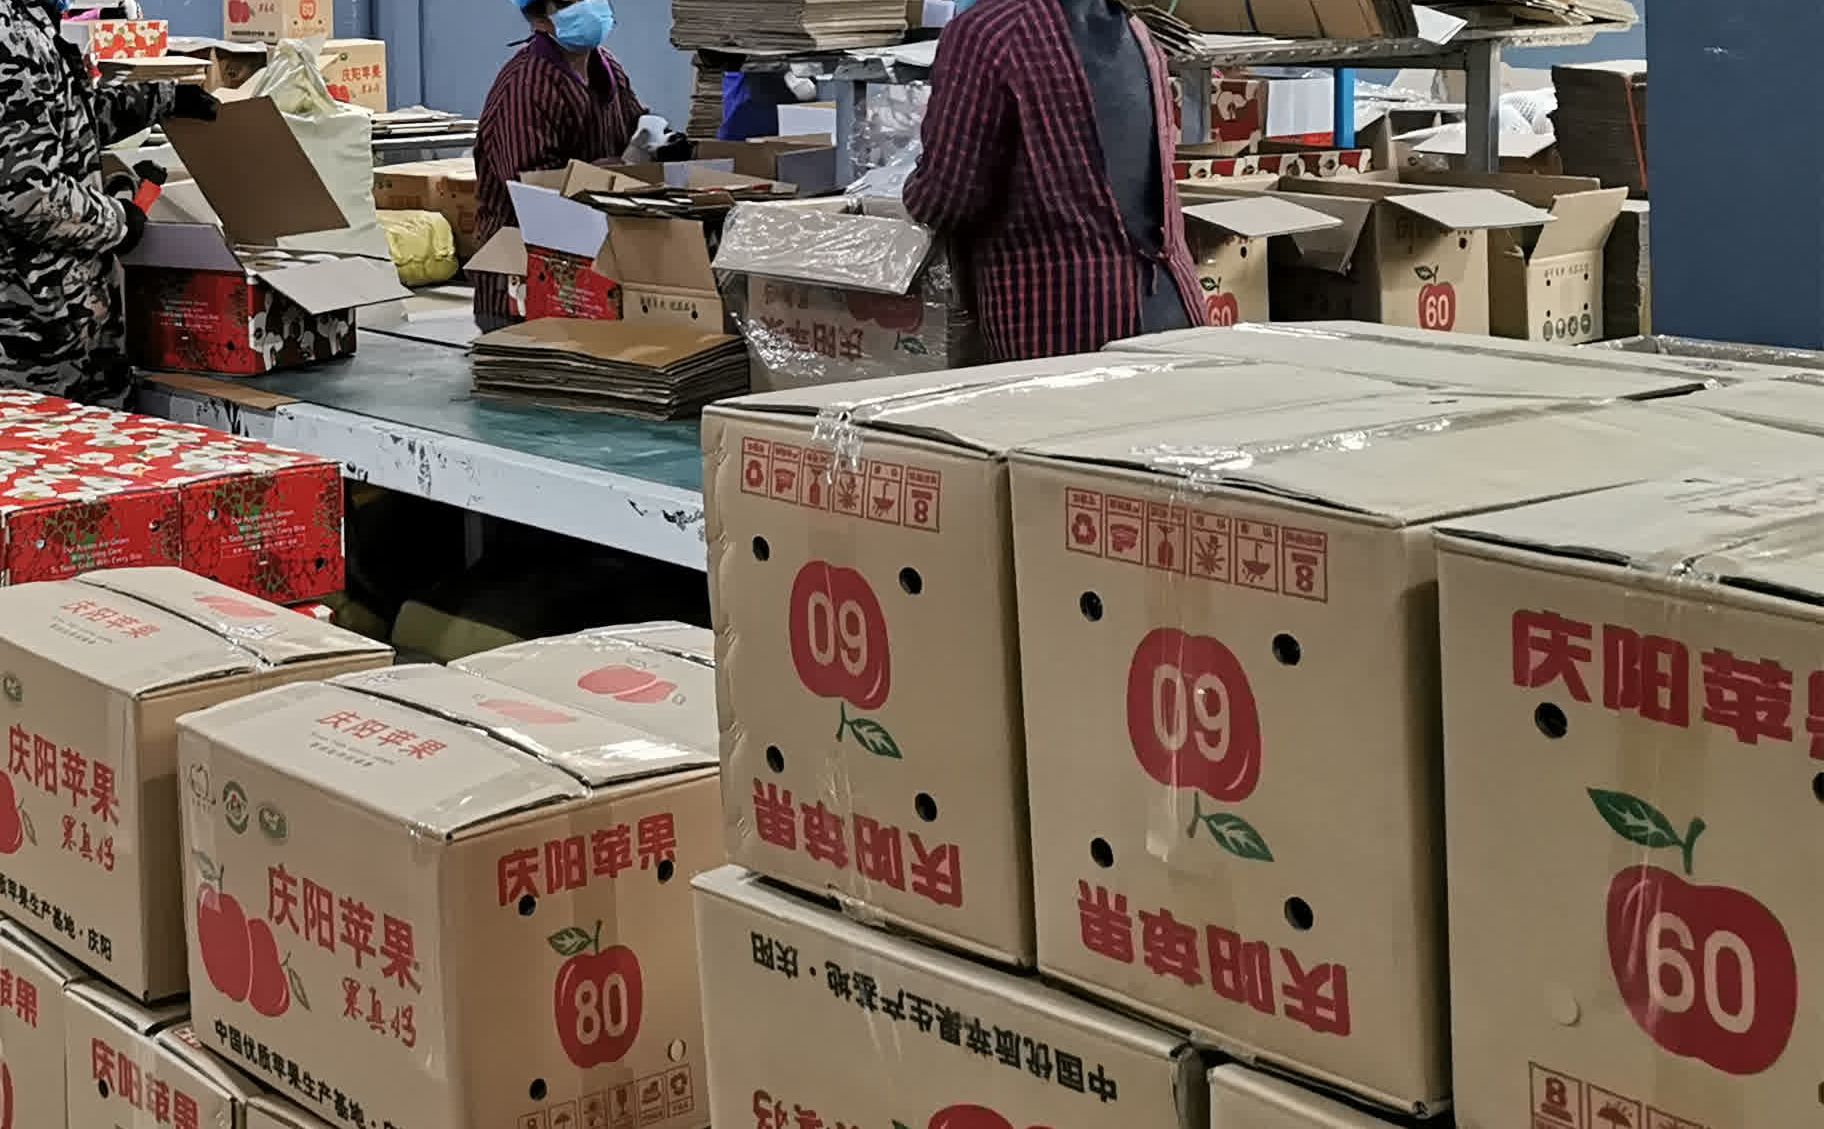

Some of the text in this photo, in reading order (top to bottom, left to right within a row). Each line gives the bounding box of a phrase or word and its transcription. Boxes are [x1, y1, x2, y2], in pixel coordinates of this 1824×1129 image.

[1423, 294, 1449, 328] 60
[7, 723, 120, 827] 庆阳苹果
[316, 710, 448, 760] 庆阳苹果
[497, 812, 677, 907] 庆阳苹果
[751, 777, 965, 909] 庆阳苹果
[267, 862, 422, 995] 庆阳苹果
[1077, 878, 1351, 1038] 庆阳苹果
[1648, 910, 1756, 1035] 60
[575, 972, 629, 1045] 80
[214, 1018, 404, 1129] 中国优质苹果生产基地·
